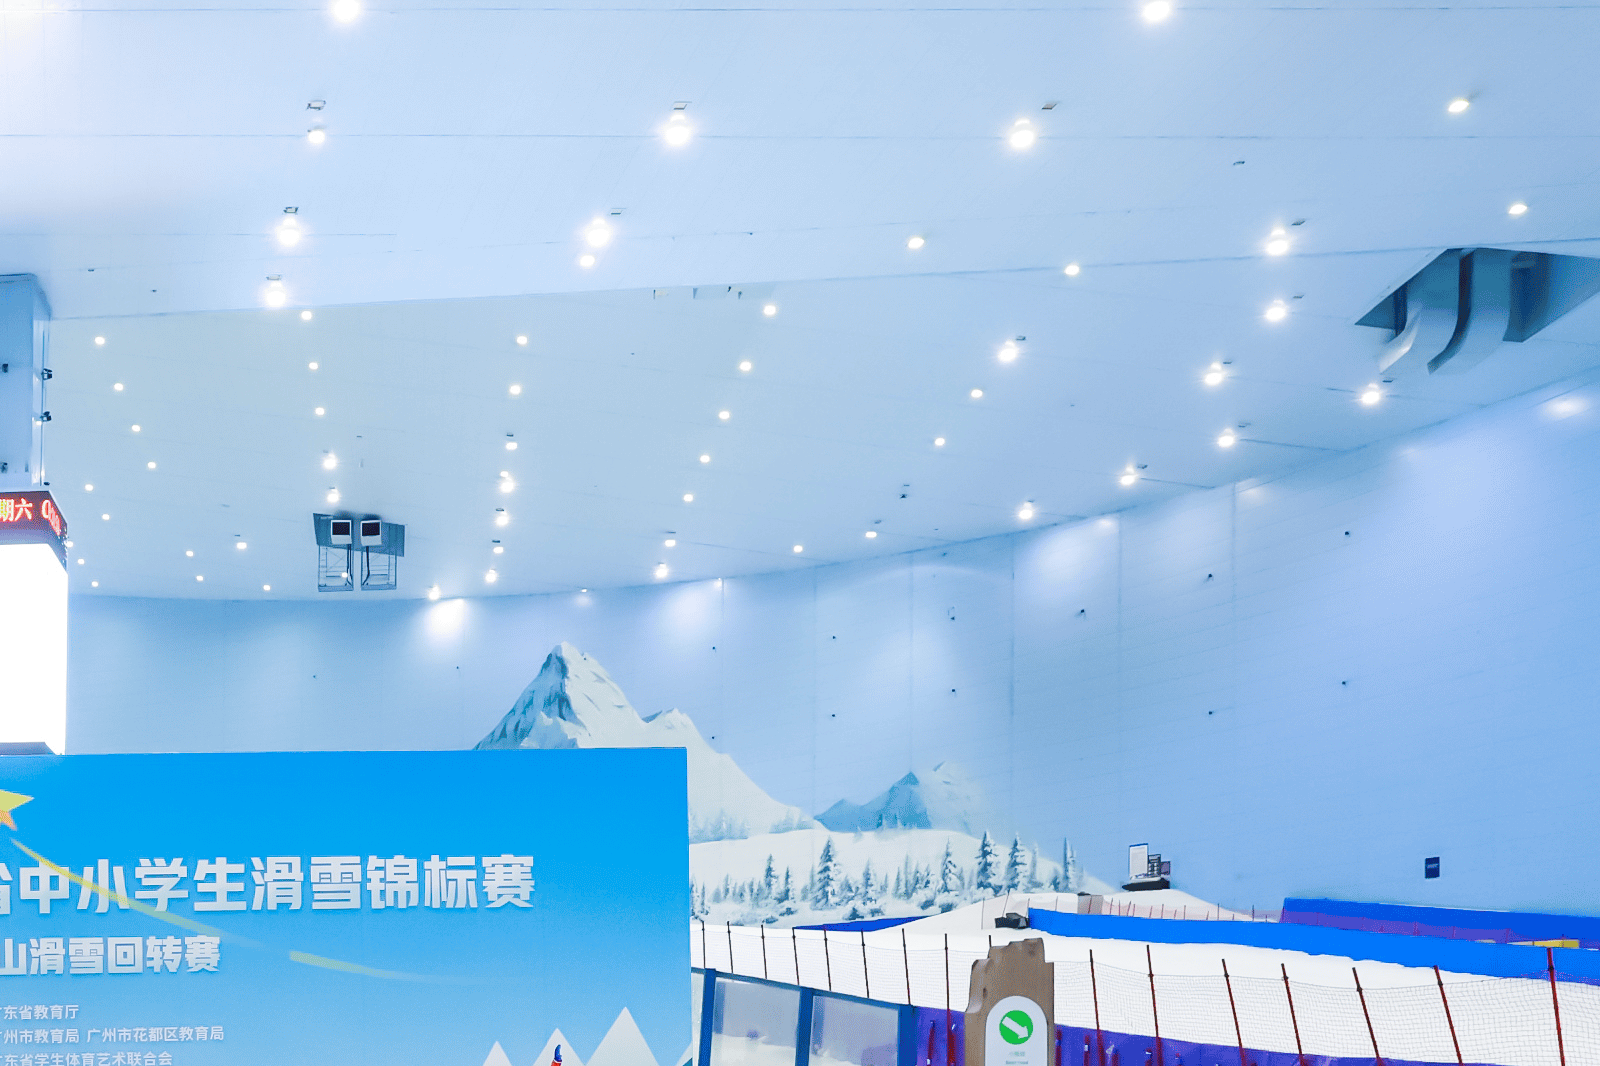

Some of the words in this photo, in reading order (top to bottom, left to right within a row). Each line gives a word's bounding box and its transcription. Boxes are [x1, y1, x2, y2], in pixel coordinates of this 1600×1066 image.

[87, 1025, 225, 1043] 广州市花都区教育局
